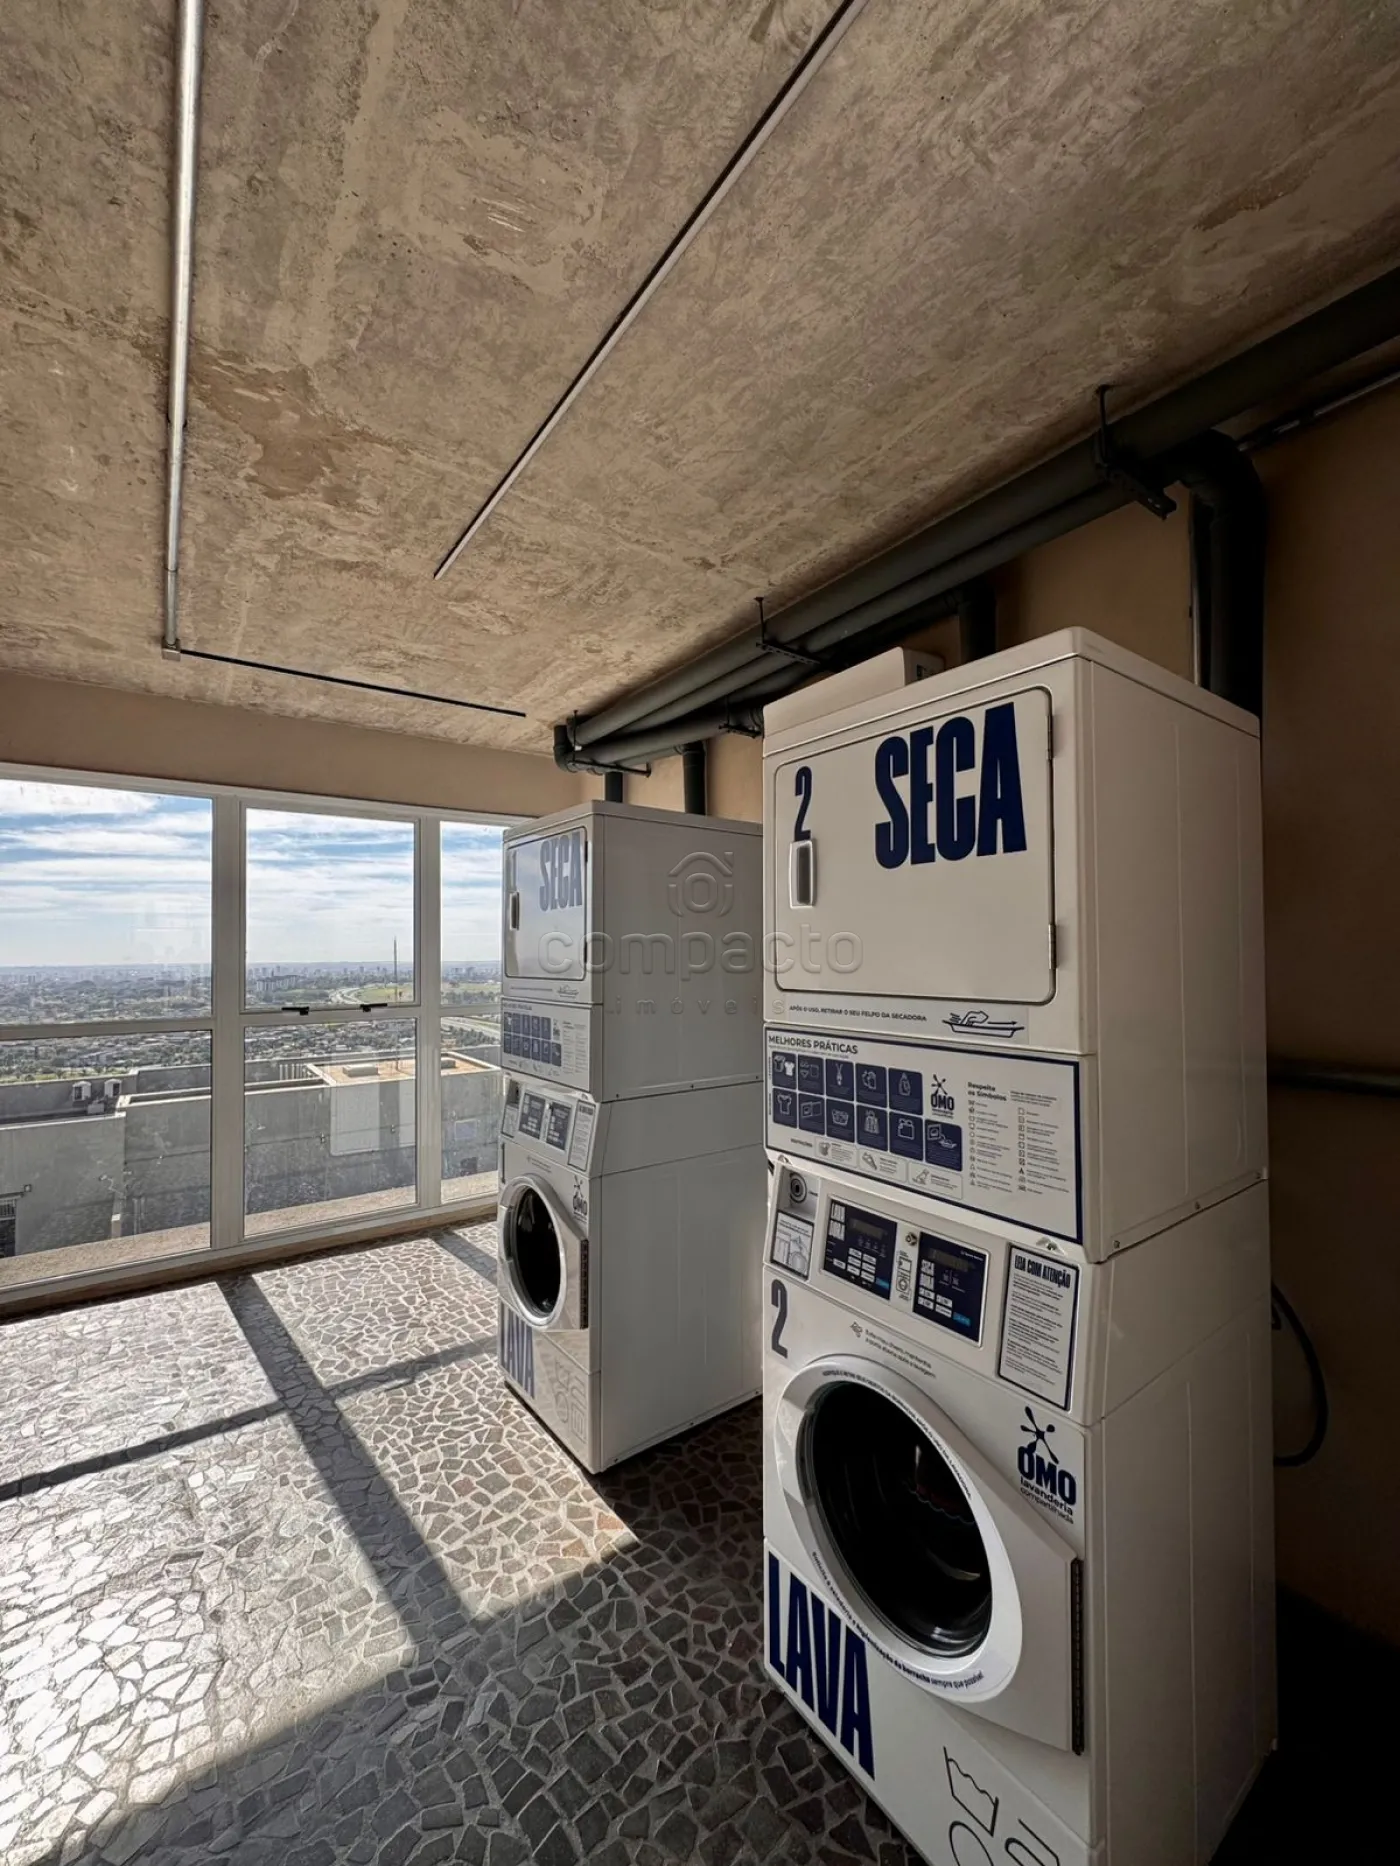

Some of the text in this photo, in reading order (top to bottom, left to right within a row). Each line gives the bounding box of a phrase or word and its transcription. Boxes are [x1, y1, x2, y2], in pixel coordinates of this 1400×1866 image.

[794, 765, 812, 842] 2
[875, 701, 1027, 869] SECA
[539, 831, 583, 912] SECA
[881, 1011, 890, 1019] DA
[891, 1012, 927, 1022] SECADORA
[768, 1035, 812, 1049] MELHORES
[813, 1038, 859, 1055] PRÁTICAS
[930, 1092, 955, 1111] OMO
[1027, 1259, 1043, 1278] COM
[1042, 1265, 1071, 1289] ATENÇÃO
[771, 1279, 788, 1359] 2
[500, 1302, 535, 1399] LAVA
[1017, 1440, 1077, 1506] OMO
[1020, 1475, 1073, 1516] lavanderia
[1020, 1487, 1074, 1525] compartilhada
[768, 1550, 876, 1781] LAVA
[902, 1663, 931, 1684] borracha
[930, 1678, 953, 1689] sempre
[952, 1679, 964, 1690] que
